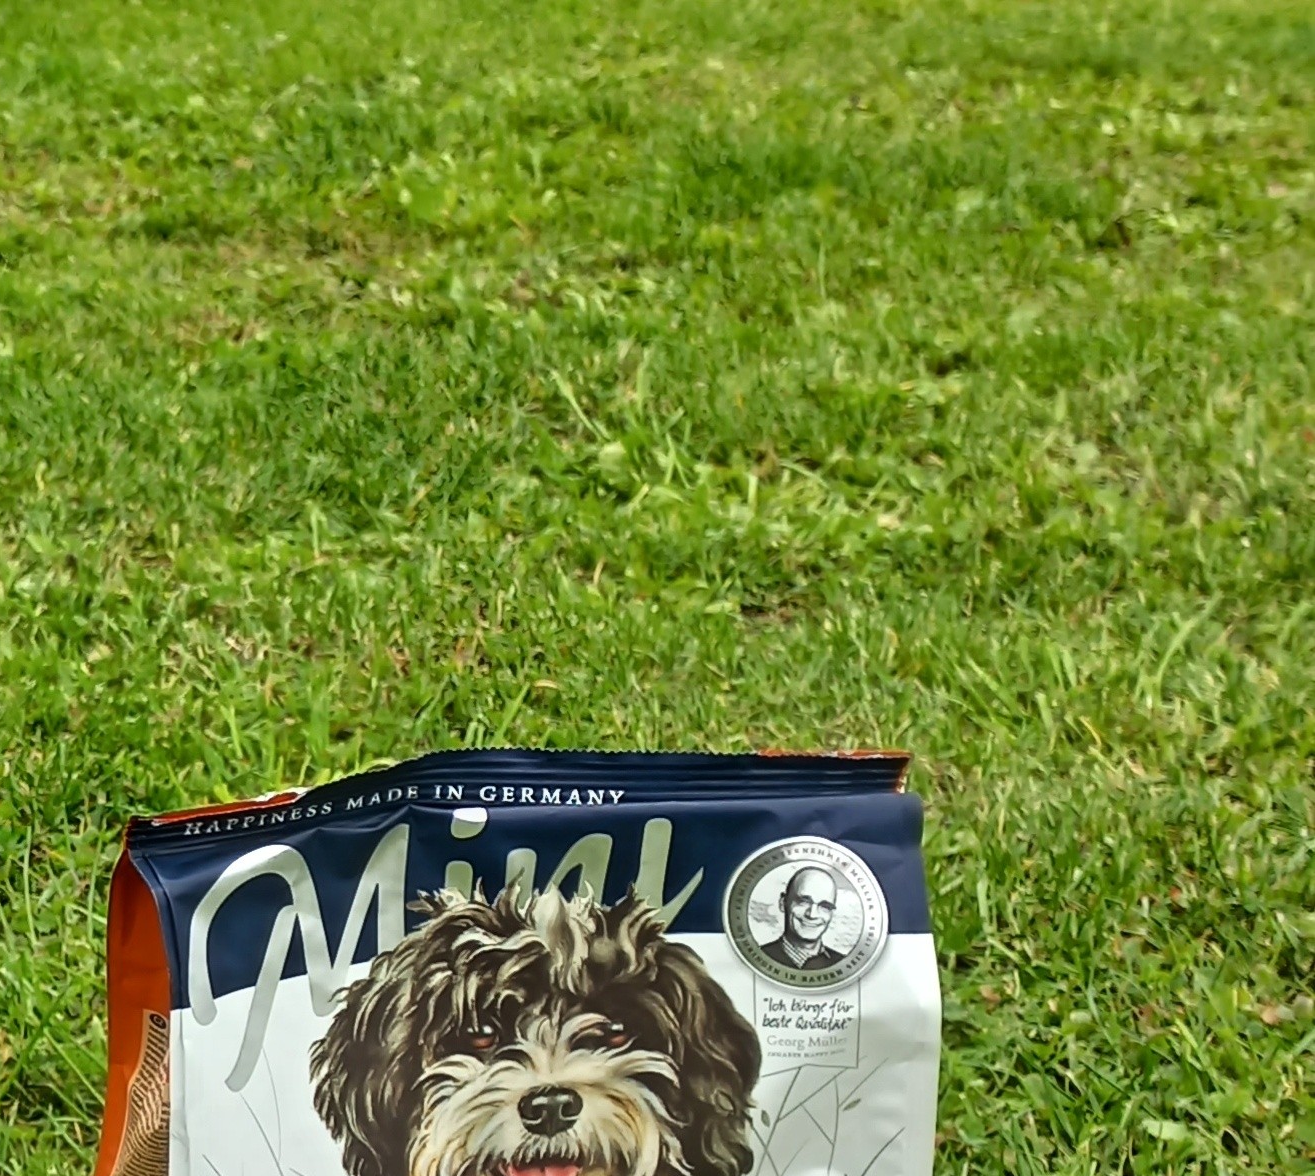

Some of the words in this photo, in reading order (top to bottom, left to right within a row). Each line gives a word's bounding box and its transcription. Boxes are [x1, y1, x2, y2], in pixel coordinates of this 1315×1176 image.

[184, 801, 332, 835] HAPPINESS
[346, 786, 419, 810] MADE
[434, 785, 464, 800] IN
[479, 785, 626, 806] GERMANY
[829, 998, 855, 1019] für
[762, 1013, 792, 1028] beste
[766, 1035, 805, 1051] Georg
